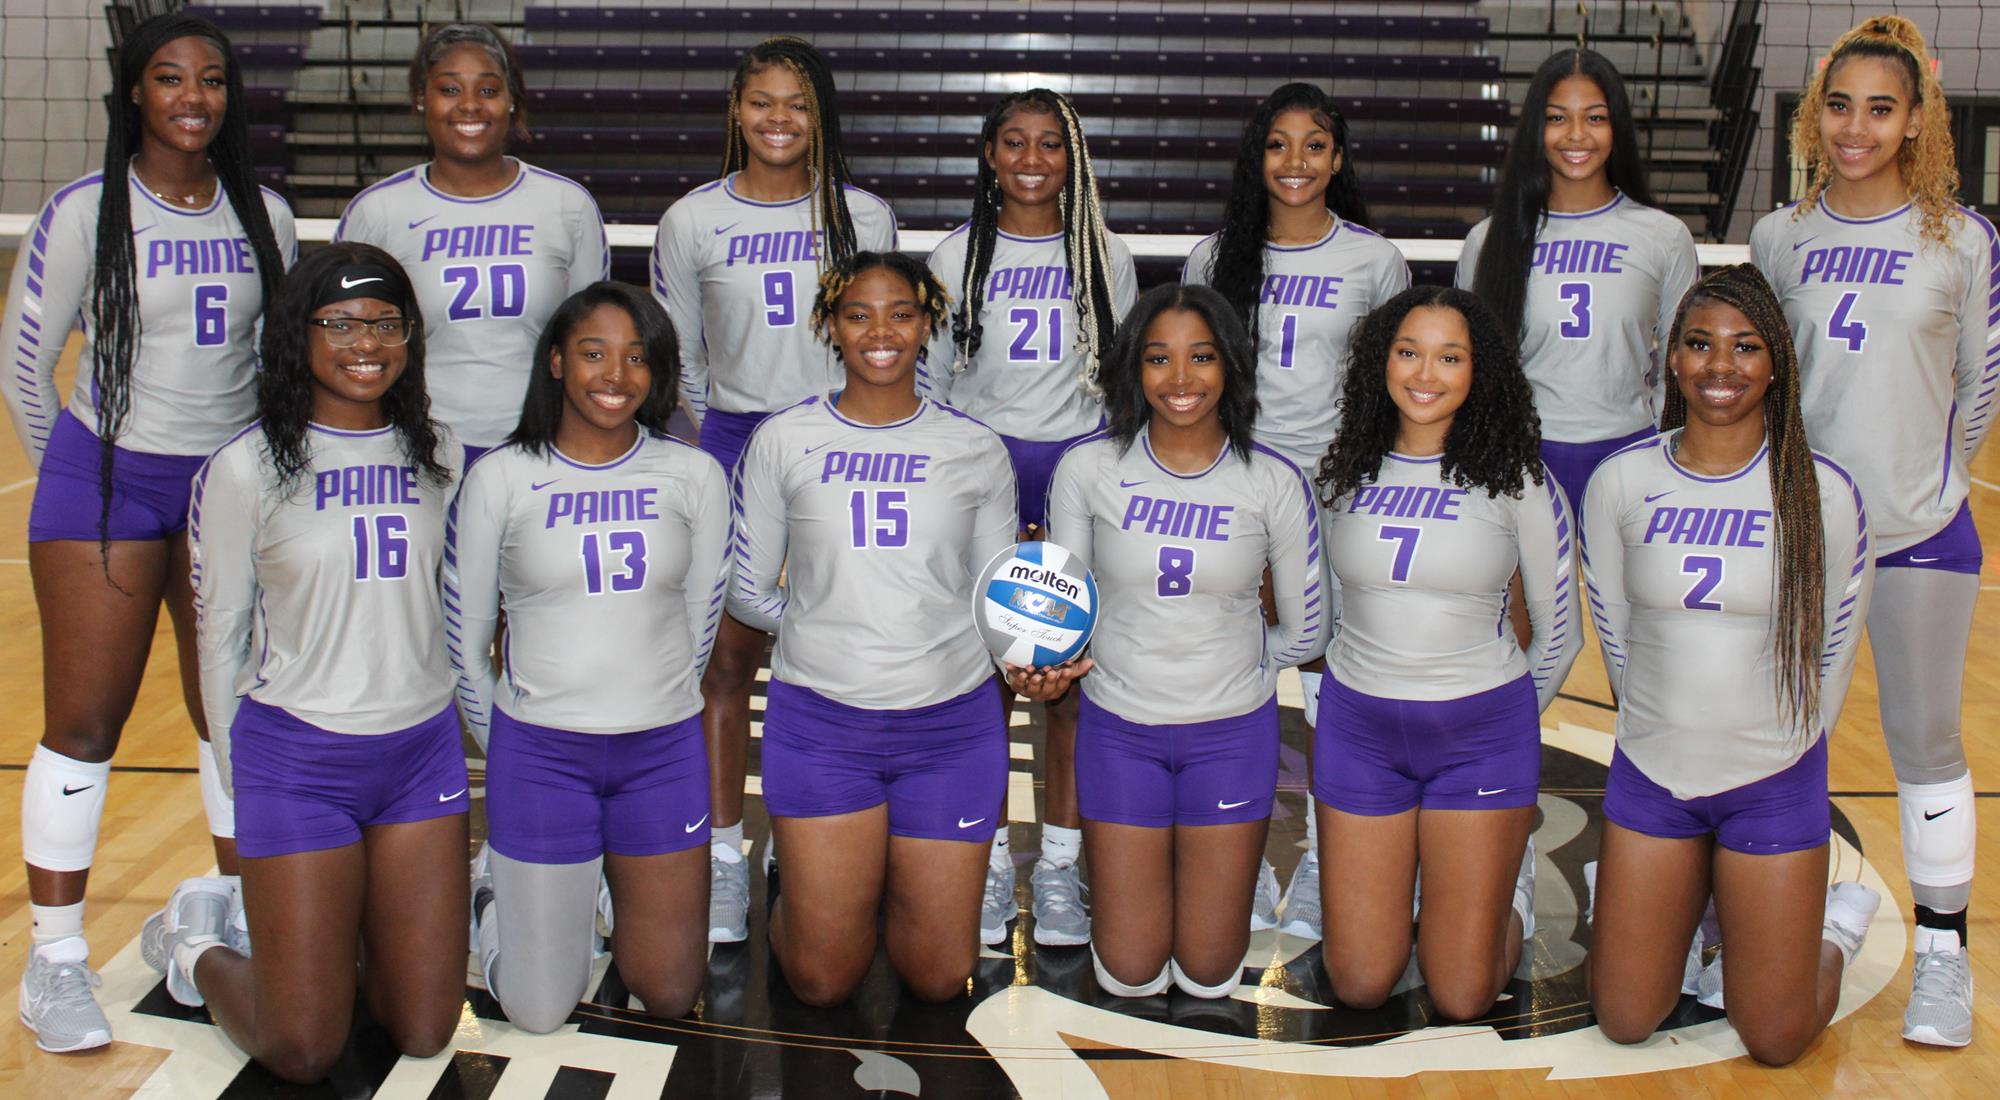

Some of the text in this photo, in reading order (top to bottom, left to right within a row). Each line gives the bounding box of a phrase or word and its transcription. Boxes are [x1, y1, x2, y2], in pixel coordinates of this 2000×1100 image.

[146, 238, 255, 278] PAINE
[421, 224, 534, 261] PAINE
[726, 230, 823, 267] PAINE
[1800, 246, 1914, 286] PAINE
[441, 262, 528, 323] 20
[761, 269, 798, 329] 9
[1259, 273, 1344, 309] AINE
[1558, 280, 1593, 341] 3
[193, 282, 230, 349] 6
[1008, 306, 1063, 363] 21
[1826, 291, 1869, 354] 4
[1279, 312, 1298, 370] 1
[315, 464, 421, 511] PAINE
[820, 451, 932, 484] PAINE
[545, 487, 660, 529] PAINE
[847, 488, 910, 551] 15
[1121, 494, 1235, 542] PAINE
[1348, 485, 1468, 521] PAINE
[1643, 506, 1773, 548] PAINE
[351, 513, 411, 582] 16
[579, 528, 649, 597] 13
[1155, 543, 1197, 600] 8
[1376, 522, 1424, 584] 7
[1008, 586, 1069, 622] NCAA
[1009, 565, 1079, 600] molten
[1680, 552, 1726, 613] 2
[998, 613, 1027, 633] Super
[1030, 628, 1065, 643] Touch
